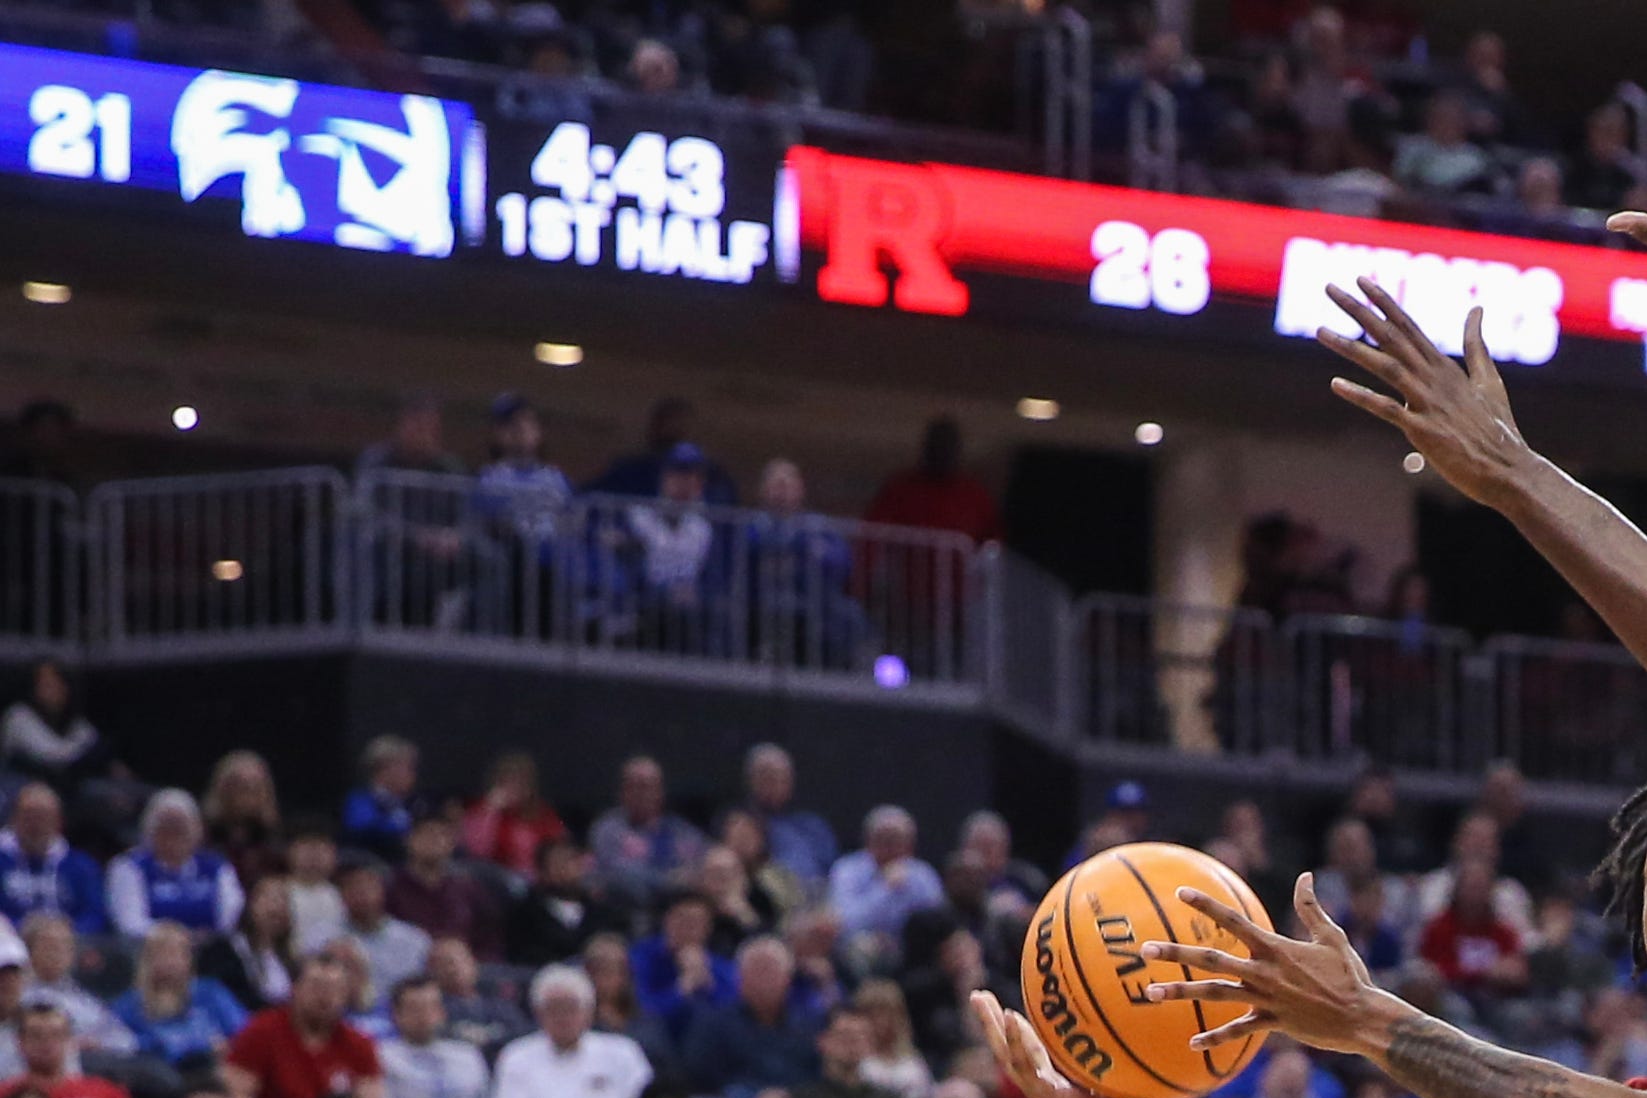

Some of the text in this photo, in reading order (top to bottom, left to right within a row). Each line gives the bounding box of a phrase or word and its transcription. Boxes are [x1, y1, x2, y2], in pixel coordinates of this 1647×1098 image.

[28, 86, 131, 183] 21
[531, 121, 725, 219] 4:43
[496, 194, 770, 285] 1ST HALF
[817, 158, 970, 317] R
[1036, 906, 1113, 1080] Wilson
